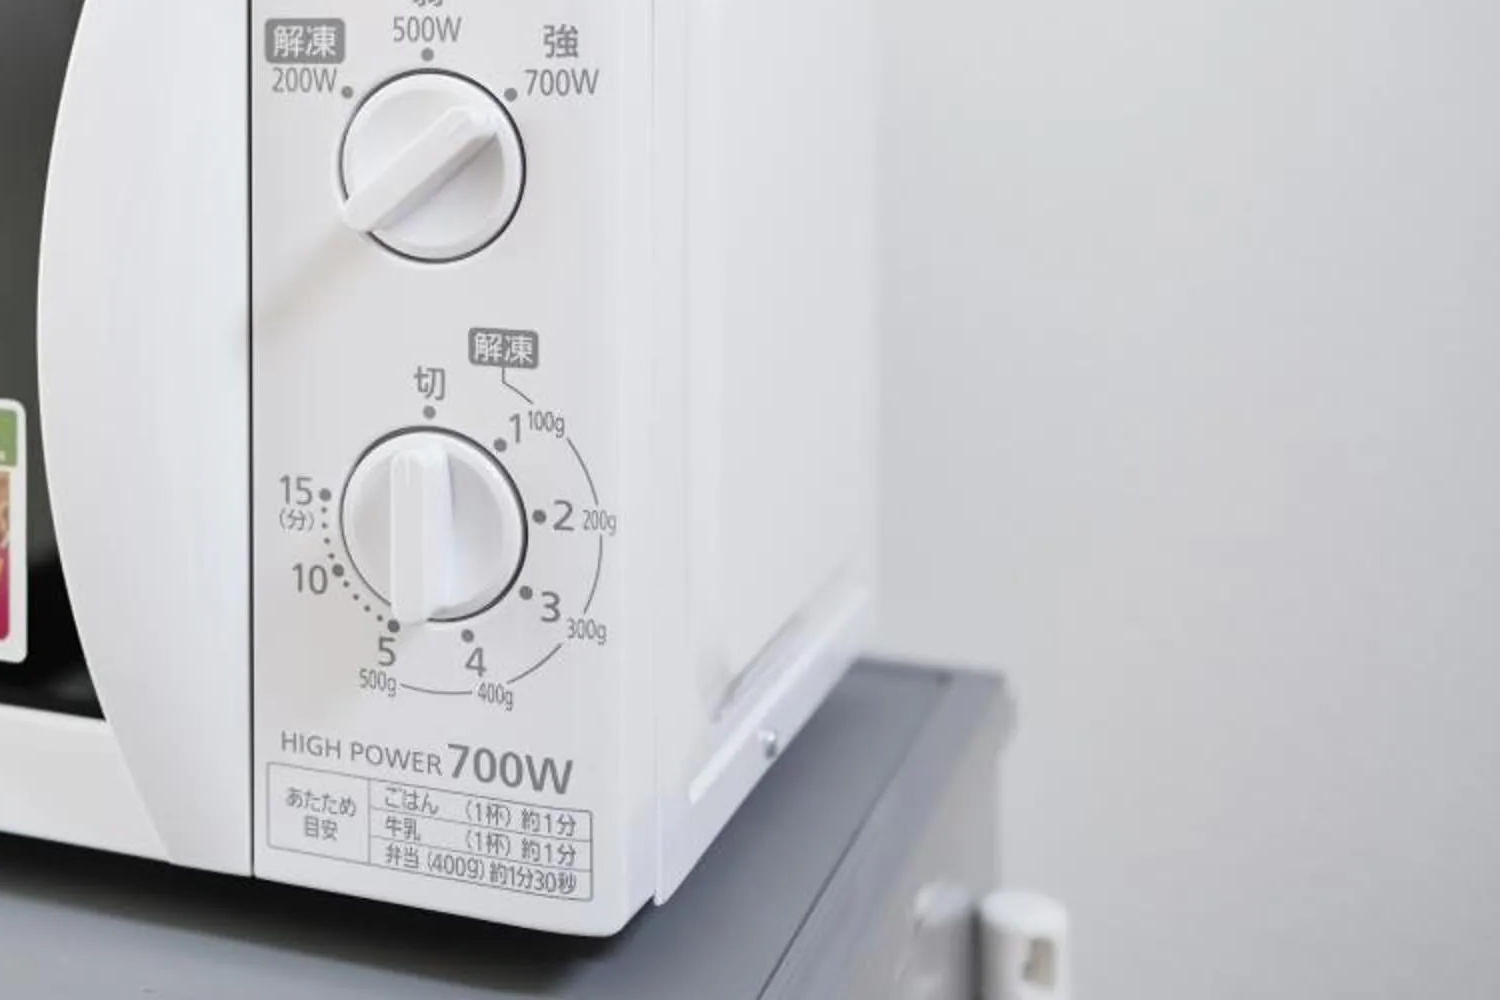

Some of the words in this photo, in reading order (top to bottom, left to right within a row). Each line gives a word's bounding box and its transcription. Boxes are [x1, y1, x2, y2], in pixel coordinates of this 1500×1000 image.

[272, 24, 337, 58] 解凍
[394, 16, 462, 42] 500W
[544, 24, 578, 58] 強
[272, 67, 337, 93] 200W
[525, 68, 599, 96] 700W
[472, 332, 534, 364] 解凍
[414, 366, 445, 401] 切
[509, 413, 522, 443] 1
[528, 410, 565, 438] 100g
[280, 475, 312, 506] 15
[278, 510, 316, 532] (分)
[553, 500, 574, 531] 2
[582, 511, 617, 535] 200g
[292, 563, 328, 595] 10
[541, 591, 560, 622] 3
[567, 617, 606, 646] 300g
[378, 636, 396, 666] 5
[465, 647, 487, 677] 4
[359, 665, 396, 697] 500g
[477, 684, 514, 710] 400g
[281, 731, 340, 759] HIGH
[350, 743, 443, 776] POWER
[447, 744, 574, 795] 700W
[285, 786, 357, 816] あたため
[384, 786, 439, 816] ごはん
[521, 808, 577, 838] 約1分
[303, 816, 339, 841] 目安
[384, 816, 422, 842] 牛乳
[521, 837, 577, 867] 約1分
[384, 845, 420, 871] 弁当
[489, 864, 578, 895] 約1分30秒
